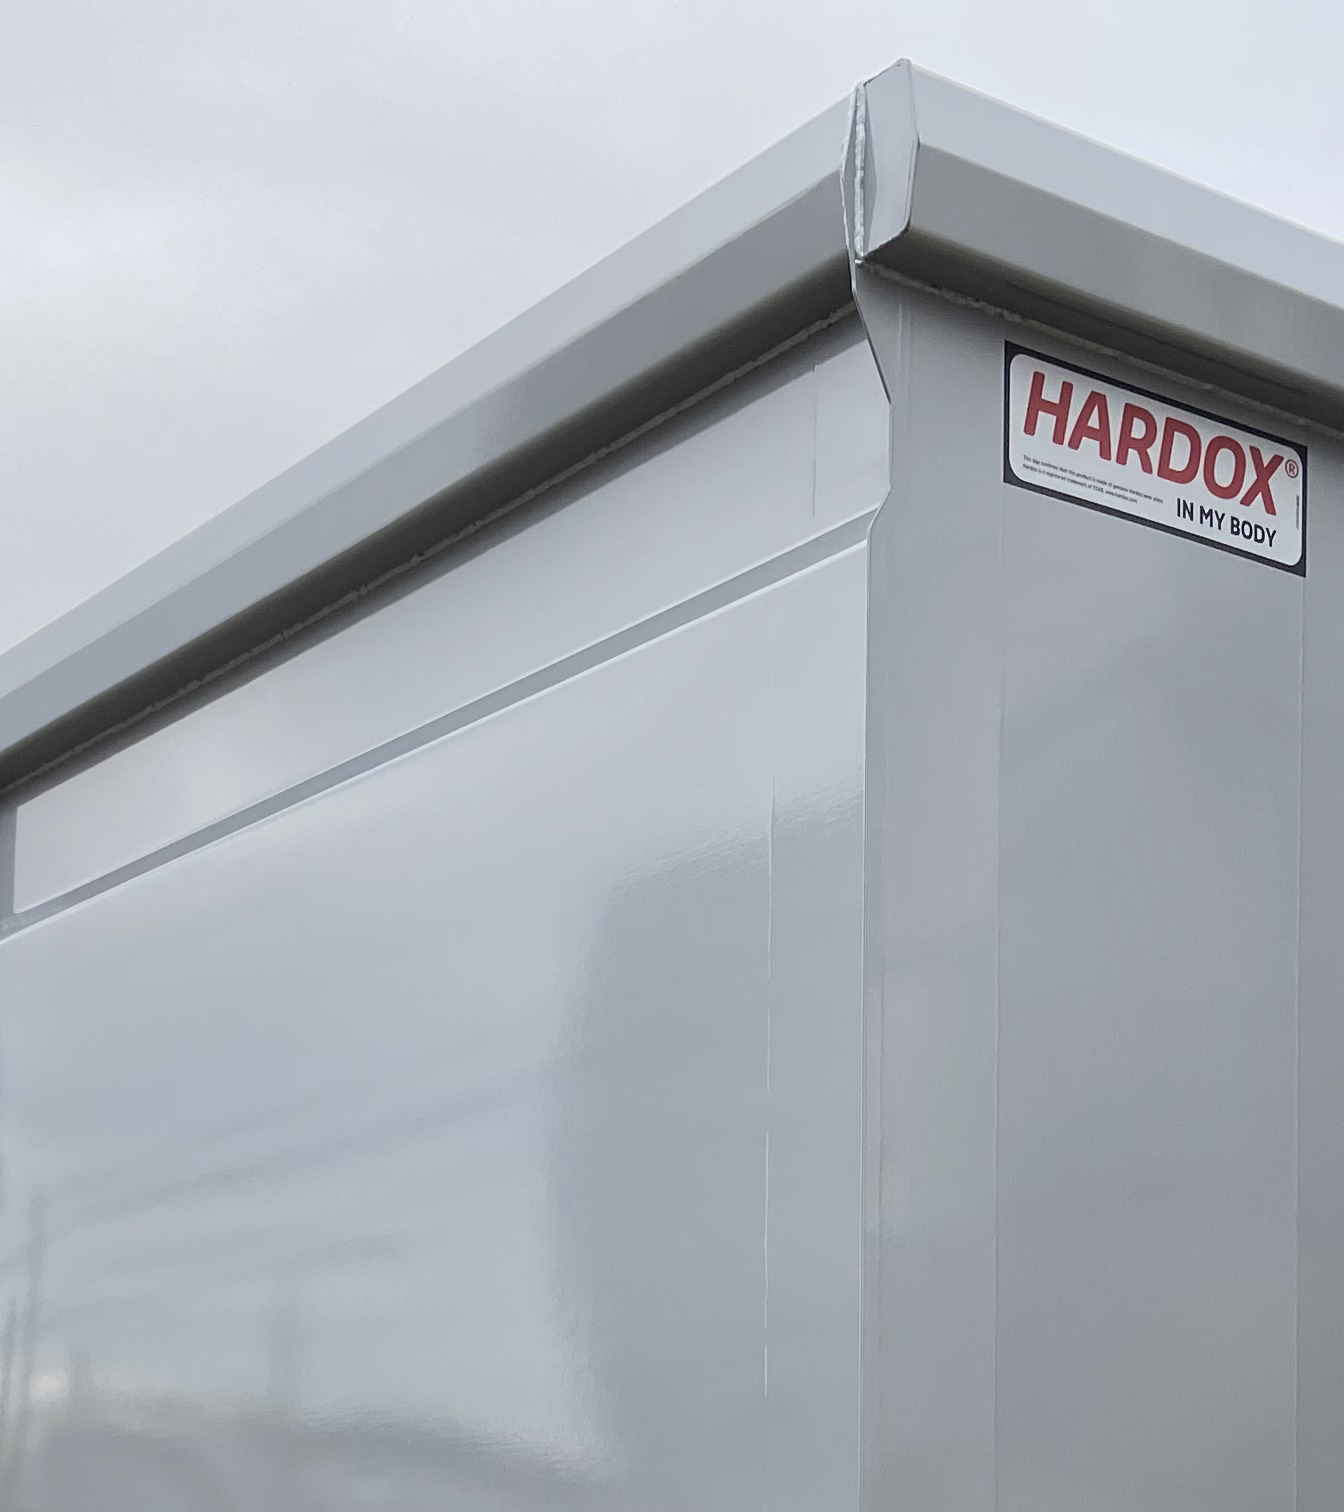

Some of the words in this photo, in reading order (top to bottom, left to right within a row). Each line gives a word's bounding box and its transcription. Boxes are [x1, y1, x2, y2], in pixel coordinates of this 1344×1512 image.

[1176, 498, 1194, 522] IN
[1199, 504, 1226, 531] MY
[1230, 516, 1277, 547] BODY
